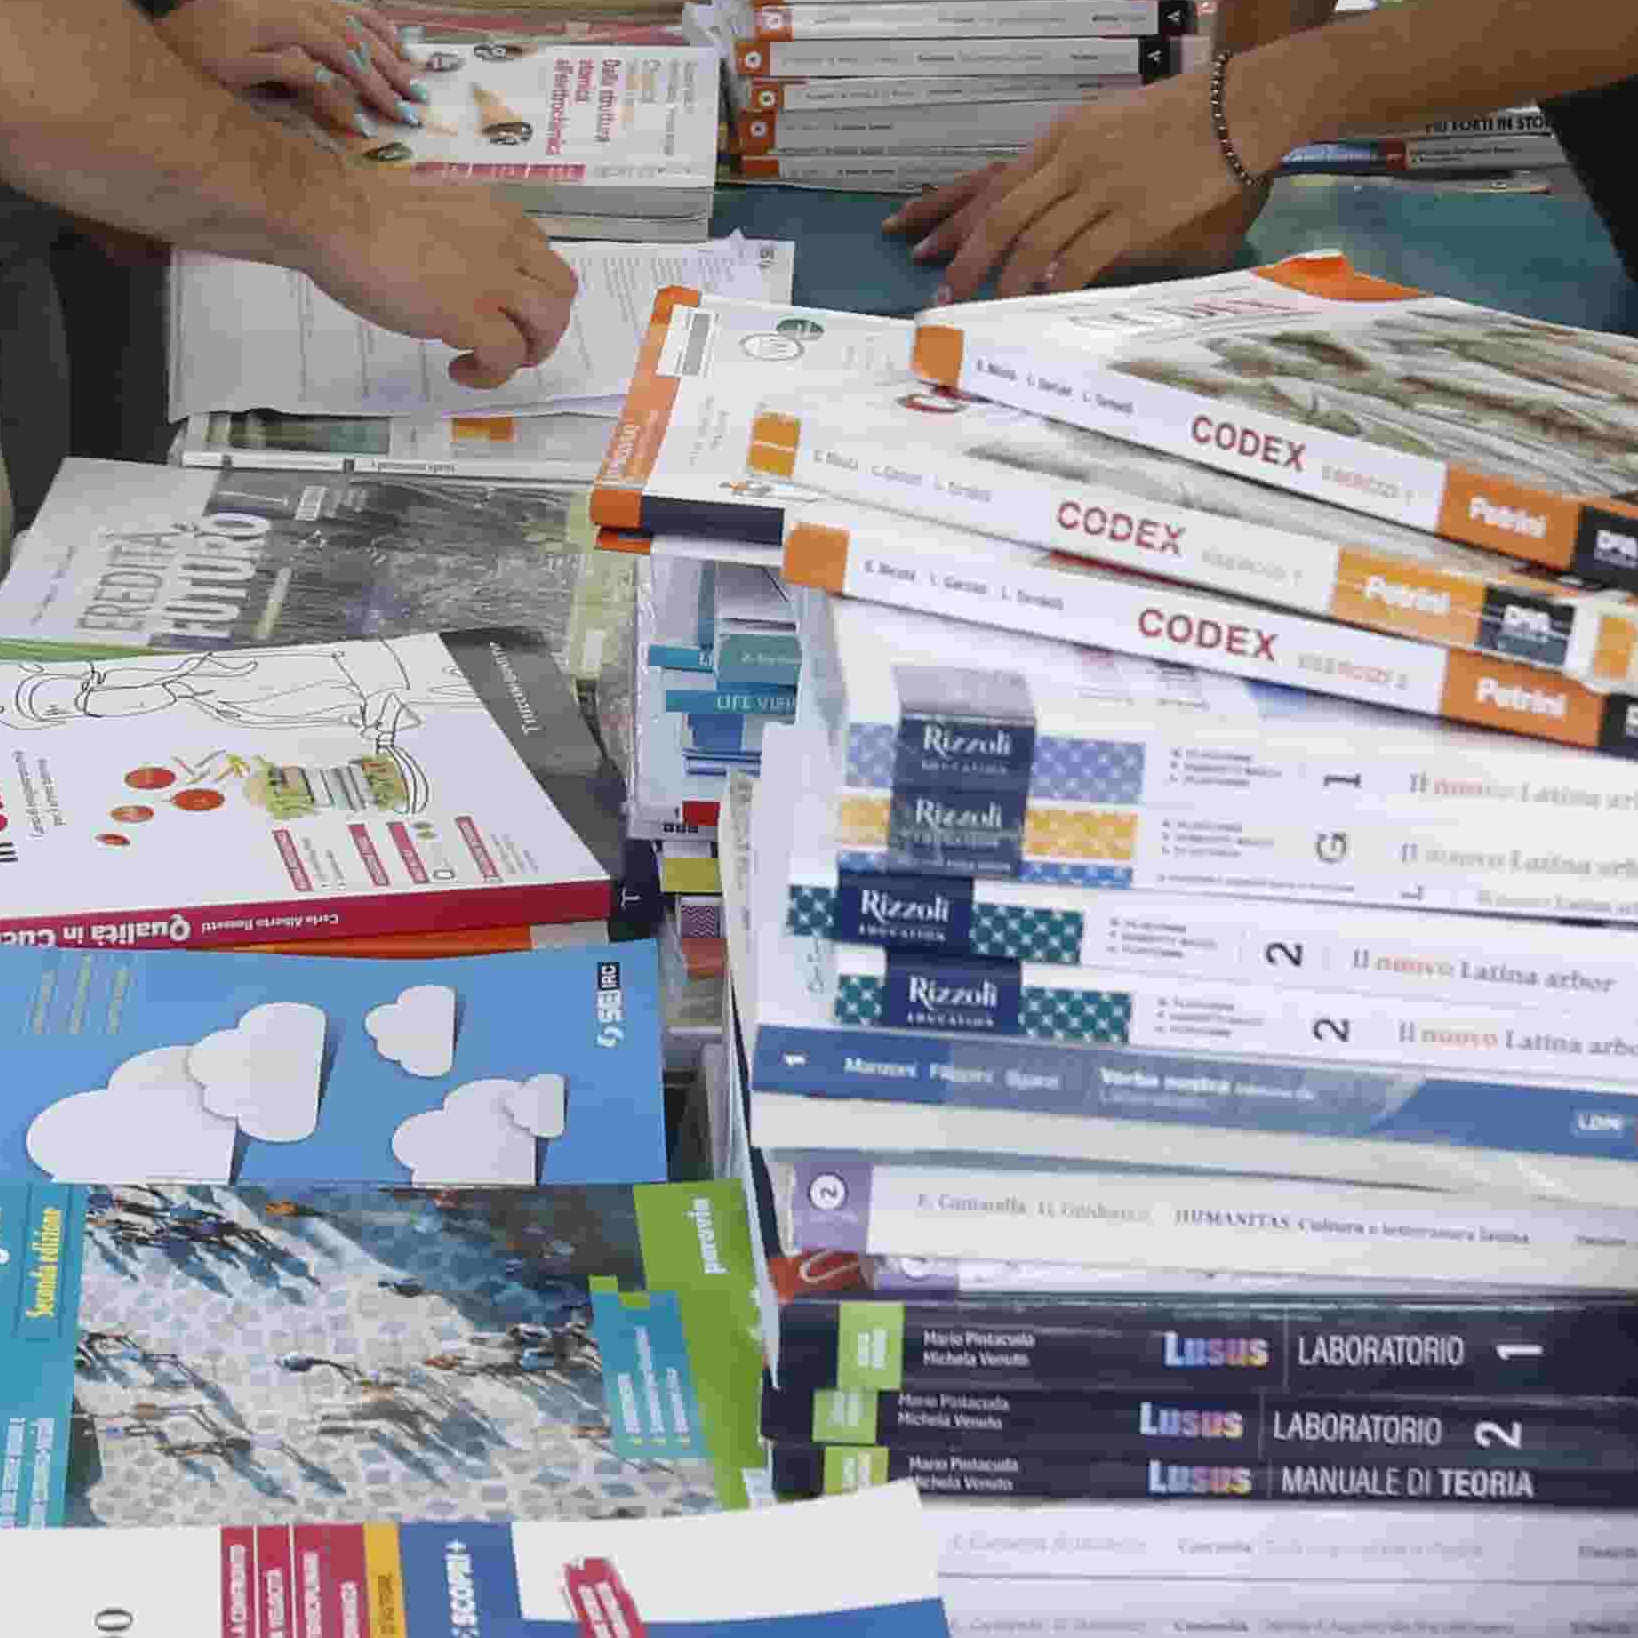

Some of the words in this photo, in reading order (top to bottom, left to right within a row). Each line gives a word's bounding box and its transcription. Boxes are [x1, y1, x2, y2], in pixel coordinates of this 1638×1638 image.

[1190, 414, 1308, 472] CODEX
[1469, 497, 1547, 539] Petrini
[1056, 500, 1186, 556] CODEX
[1137, 608, 1278, 662] CODEX
[1475, 677, 1566, 719] Petrini
[922, 726, 1012, 760] Rizzoli
[915, 796, 1003, 830] Rizzoli
[90, 913, 191, 947] Qualità
[860, 889, 951, 922] Rizzoli
[1265, 940, 1304, 967] 2
[1461, 959, 1539, 988] Latina
[1546, 965, 1617, 994] arbor
[907, 975, 999, 1009] Rizzoli
[1313, 1017, 1350, 1043] 2
[1505, 1029, 1584, 1057] Latina
[1174, 1208, 1291, 1231] HUMANITAS
[923, 1329, 962, 1349] Mario
[964, 1329, 1036, 1349] Pintacuda
[1297, 1335, 1465, 1366] LABORATORIO
[1496, 1342, 1544, 1362] 1
[922, 1348, 972, 1368] Michela
[974, 1348, 1031, 1368] Venuto
[897, 1392, 936, 1411] Mario
[897, 1410, 947, 1430] Michela
[1273, 1410, 1442, 1446] LABORATORIO
[1474, 1421, 1523, 1450] 2
[908, 1454, 947, 1474] Mario
[950, 1455, 1020, 1475] Pintacuda
[1280, 1466, 1398, 1497] MANUALE
[1400, 1467, 1431, 1496] DI
[1439, 1467, 1534, 1498] TEORIA
